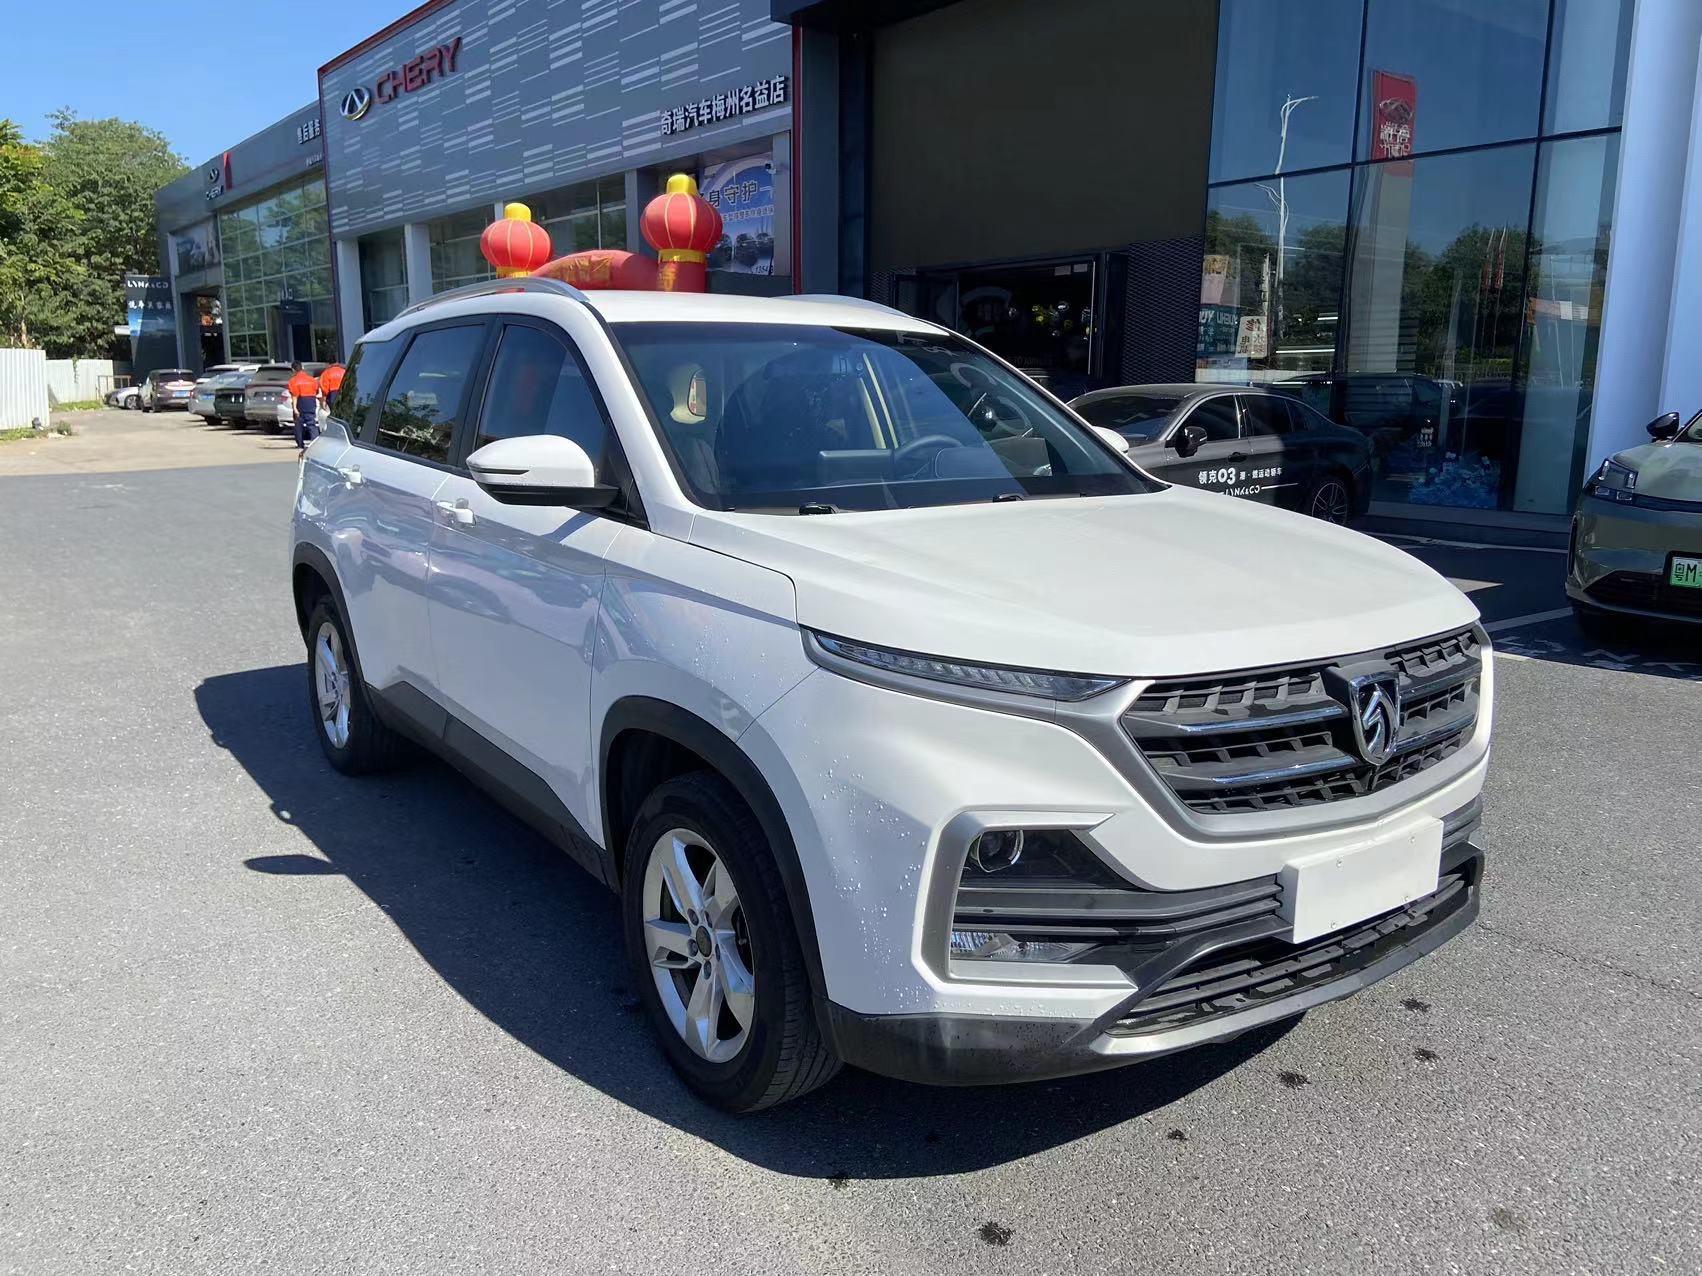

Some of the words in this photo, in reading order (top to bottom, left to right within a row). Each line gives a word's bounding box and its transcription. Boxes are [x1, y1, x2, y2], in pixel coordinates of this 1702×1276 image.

[375, 37, 462, 104] CHERY
[661, 75, 785, 135] 奇瑞汽车梅州名益店
[1198, 467, 1236, 485] 领克03
